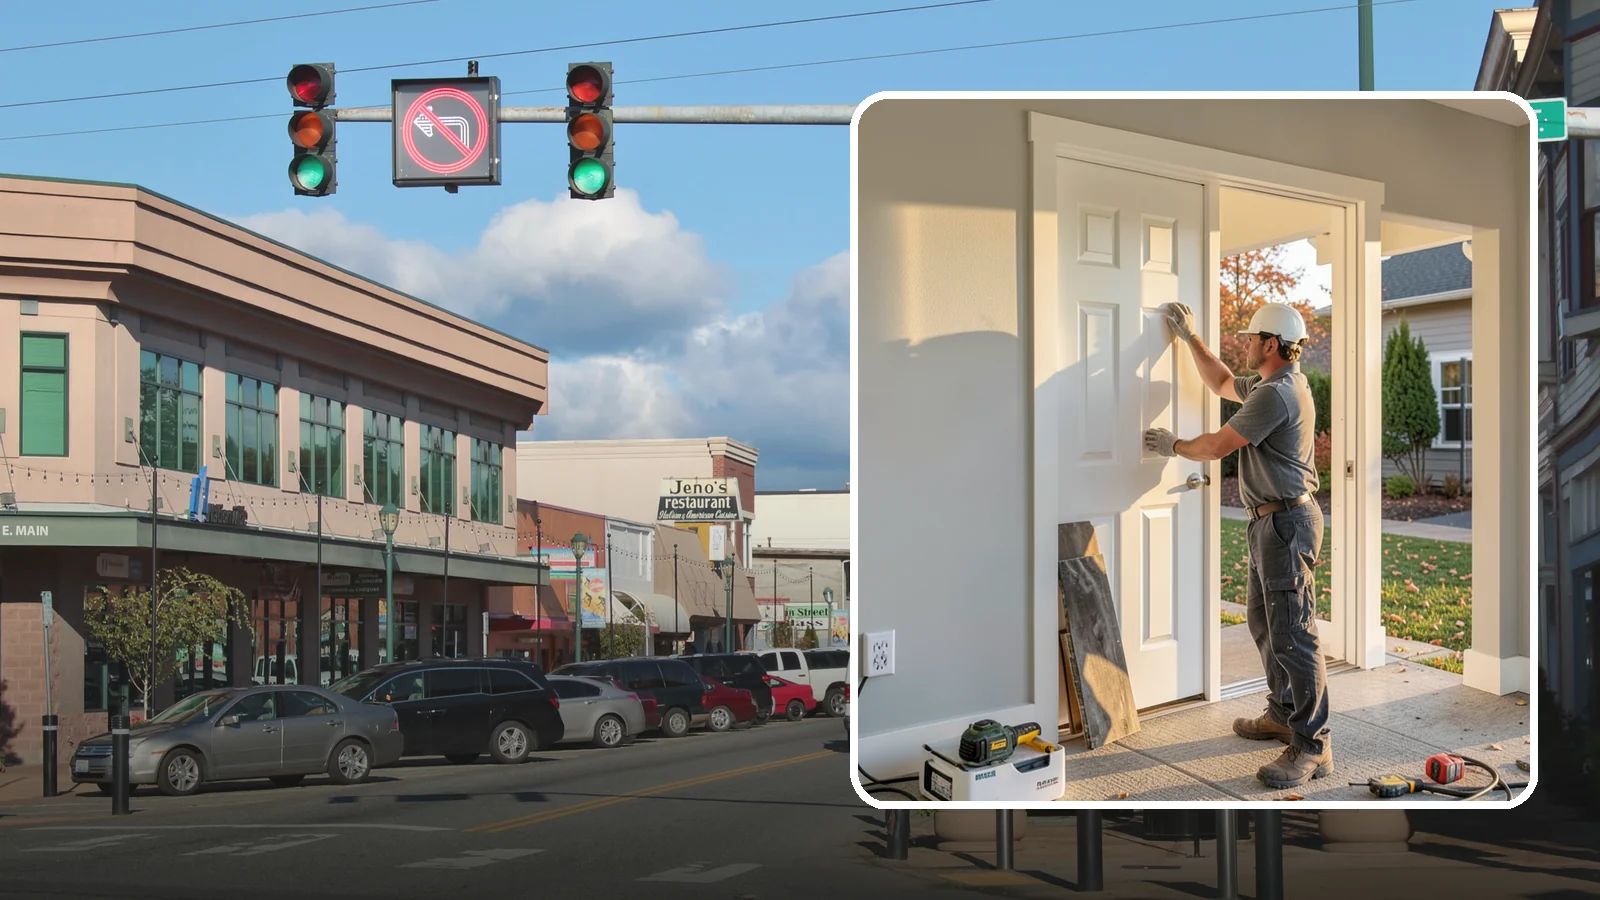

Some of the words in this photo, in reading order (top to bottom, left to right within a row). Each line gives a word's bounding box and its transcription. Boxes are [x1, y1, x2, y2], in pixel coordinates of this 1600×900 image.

[670, 480, 727, 494] Jeno's
[665, 496, 731, 509] restaurant
[659, 510, 681, 519] Italian
[686, 510, 714, 519] American
[715, 509, 737, 519] Cuisine
[2, 525, 13, 536] E.
[15, 525, 49, 536] MAIN
[797, 607, 829, 616] Street
